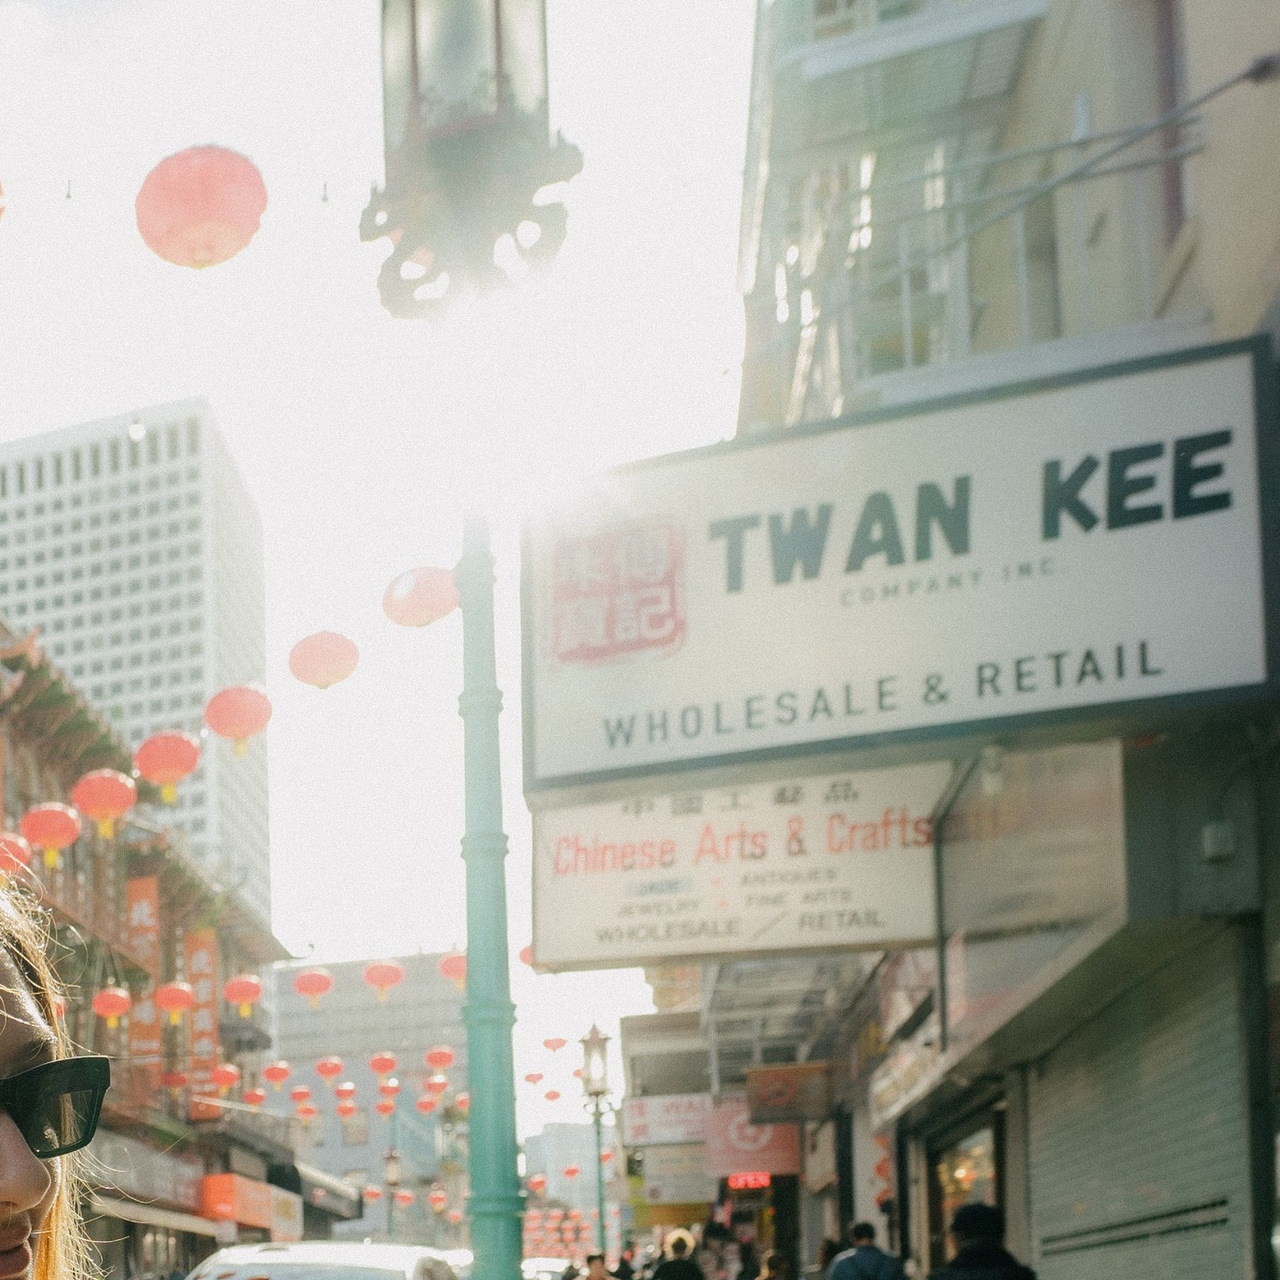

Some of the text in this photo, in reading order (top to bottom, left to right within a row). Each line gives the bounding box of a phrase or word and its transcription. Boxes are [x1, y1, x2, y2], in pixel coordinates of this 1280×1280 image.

[708, 429, 1232, 592] TWAN KEE
[840, 556, 1056, 607] COMPANY INC
[603, 639, 1164, 748] WHOLESALE & RETAIL
[553, 806, 935, 875] Chinese Arts & Crafts
[799, 908, 886, 932] RETAIL
